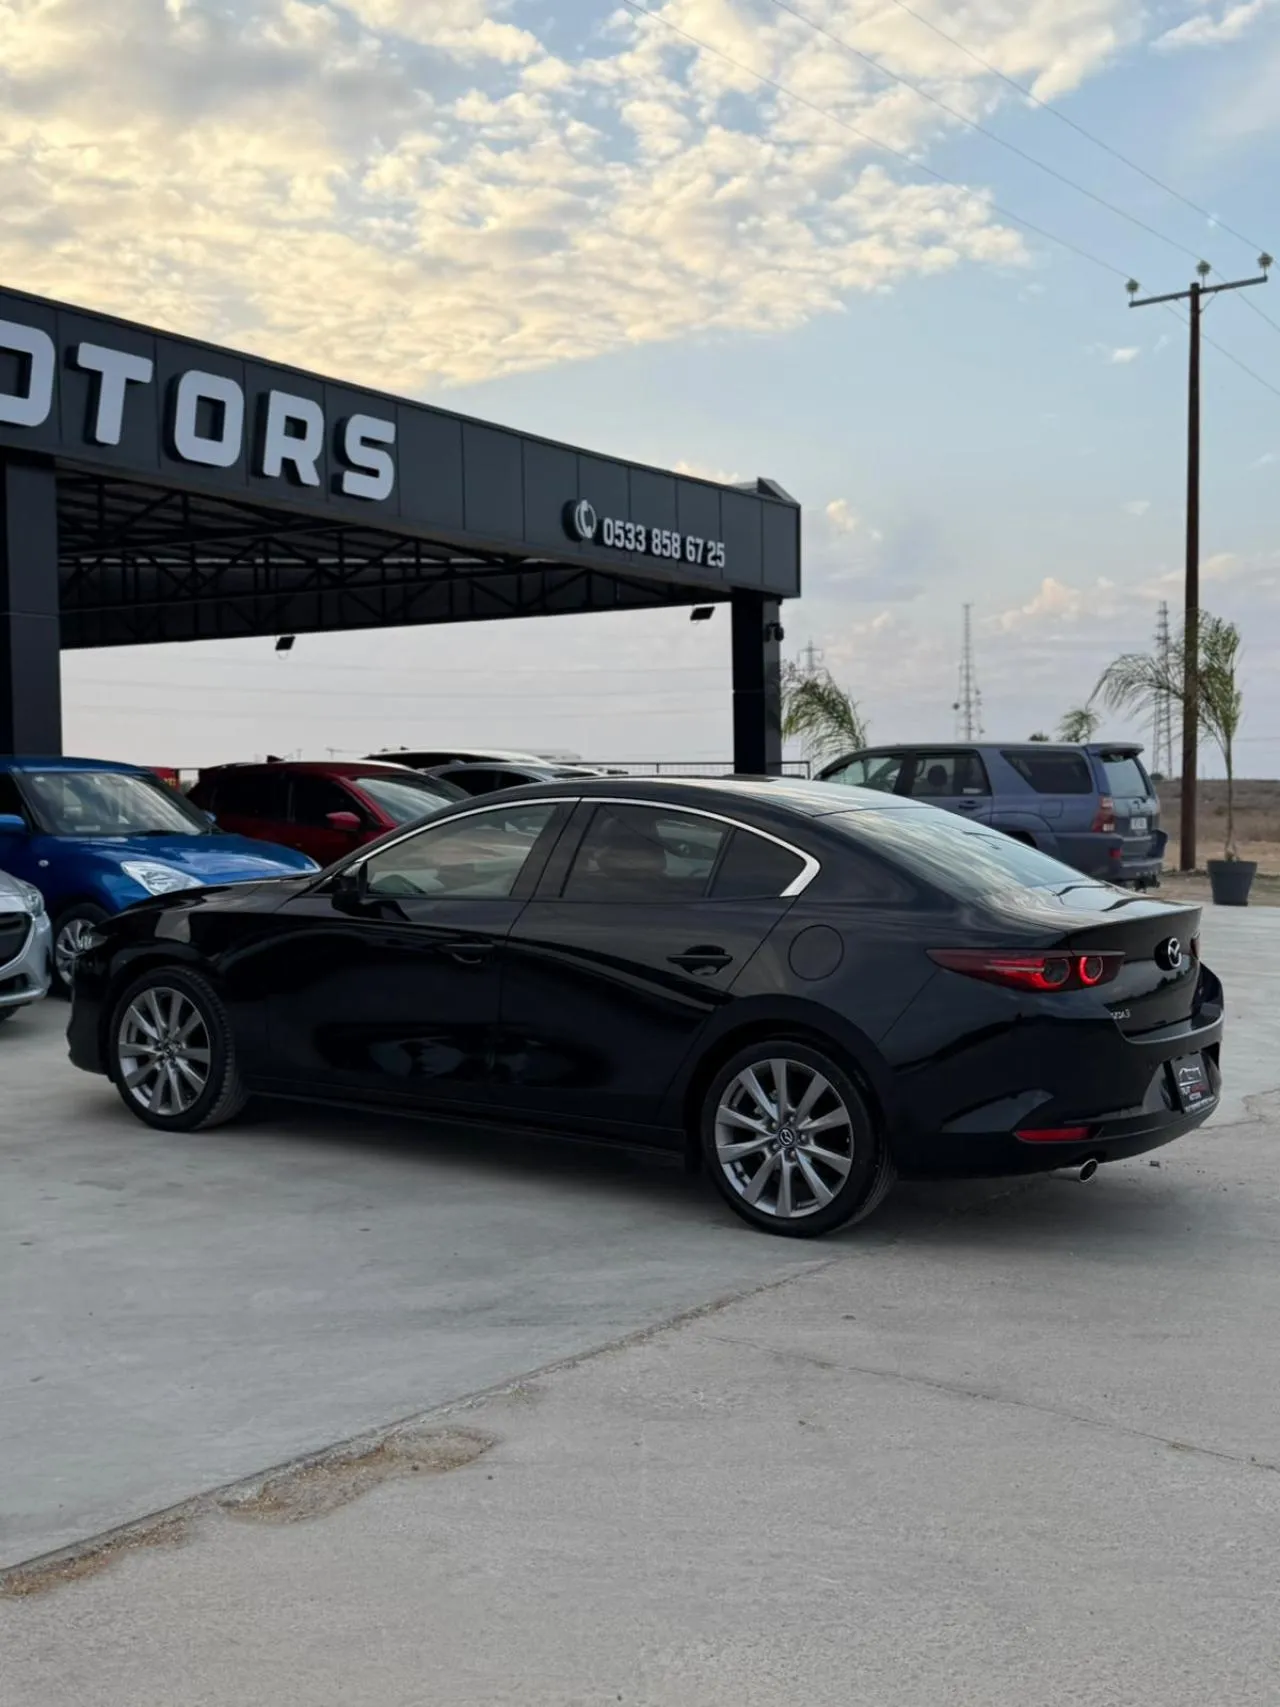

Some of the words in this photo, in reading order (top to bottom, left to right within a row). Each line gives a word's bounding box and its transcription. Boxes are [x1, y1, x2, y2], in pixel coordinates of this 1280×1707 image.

[603, 517, 646, 552] 0533
[651, 527, 681, 559] 858
[686, 535, 704, 563] 67
[707, 540, 725, 568] 25
